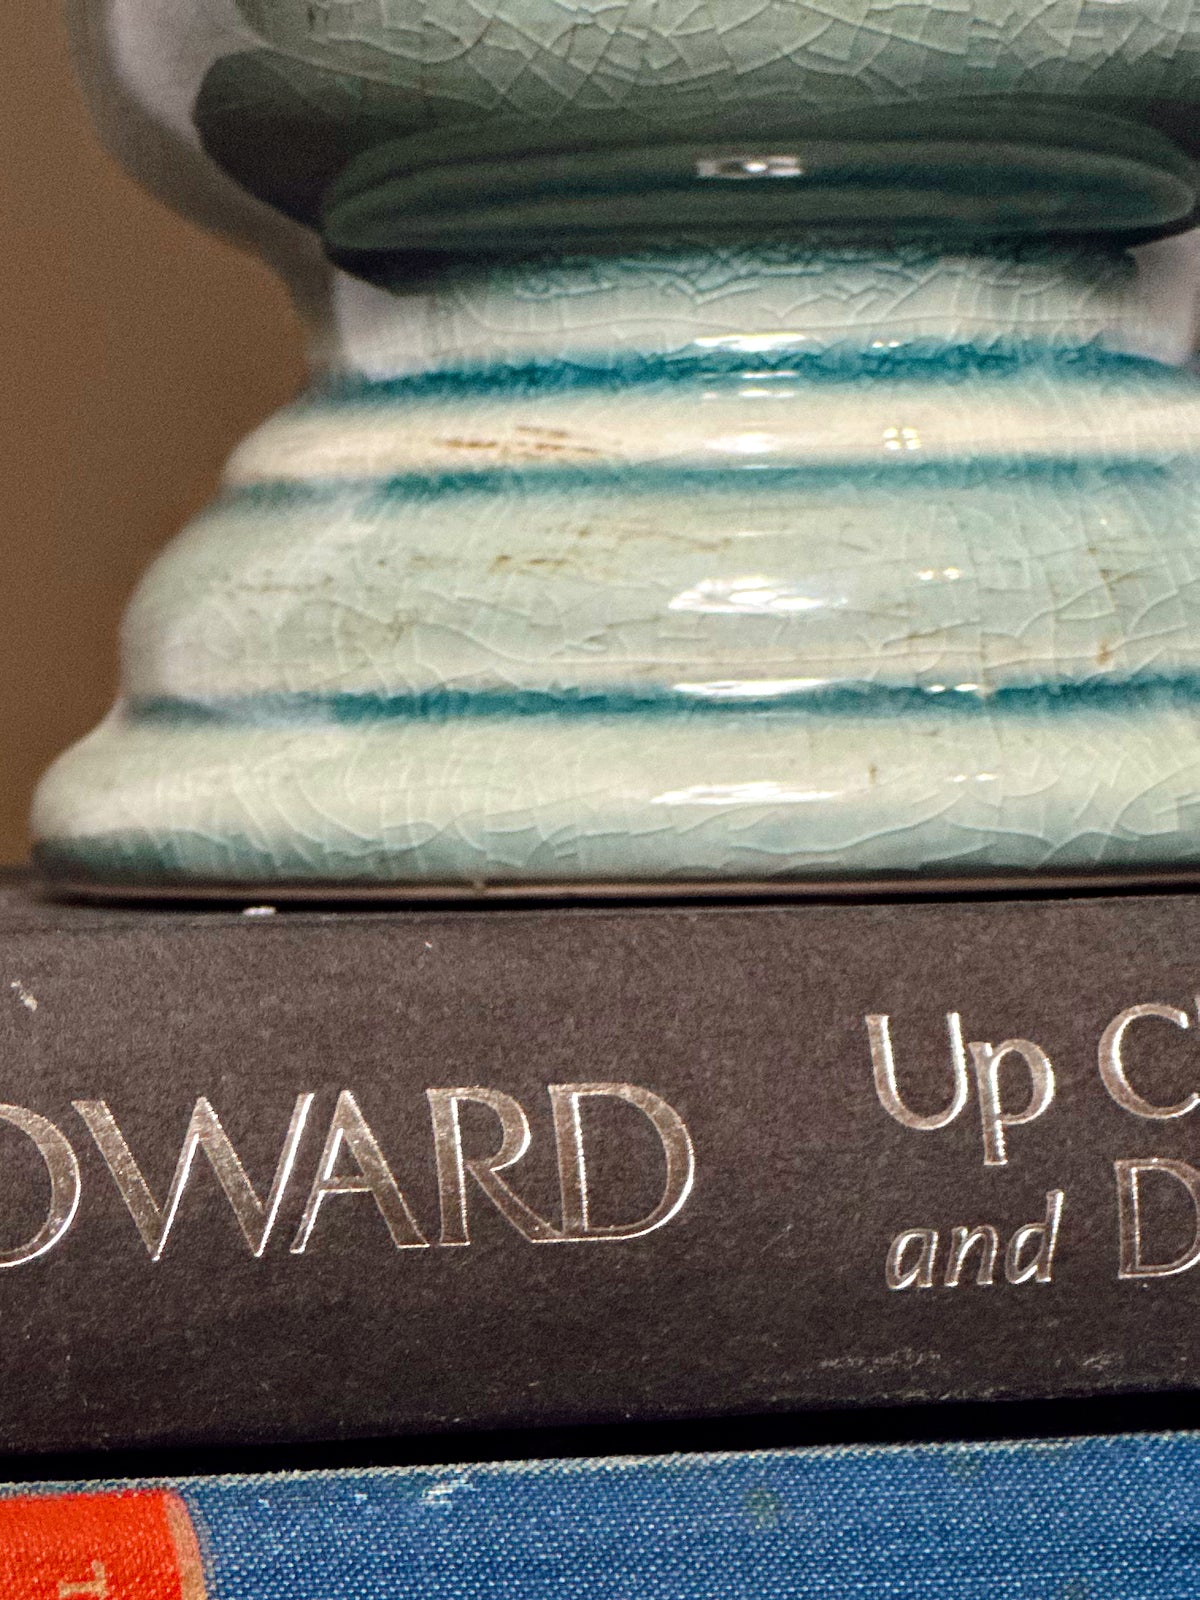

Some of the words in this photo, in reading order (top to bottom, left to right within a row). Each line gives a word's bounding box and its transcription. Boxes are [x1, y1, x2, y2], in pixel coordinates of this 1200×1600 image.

[865, 1012, 1055, 1165] Up
[1098, 997, 1200, 1120] C
[886, 1189, 1064, 1290] and
